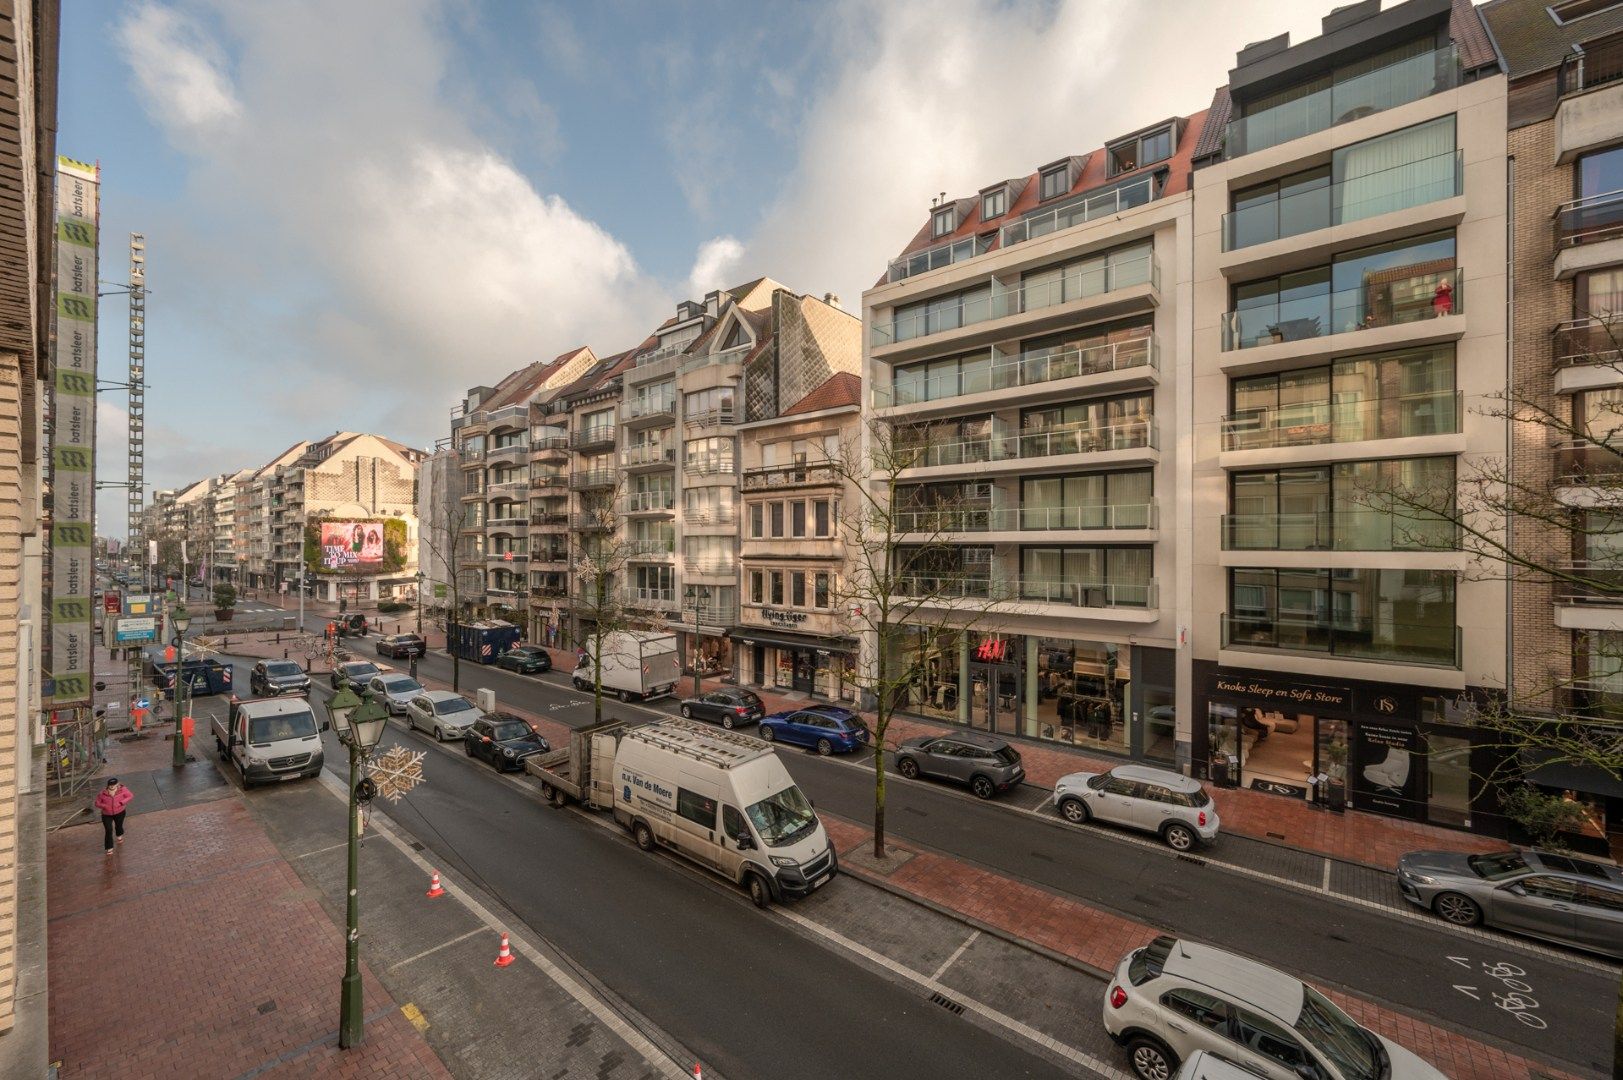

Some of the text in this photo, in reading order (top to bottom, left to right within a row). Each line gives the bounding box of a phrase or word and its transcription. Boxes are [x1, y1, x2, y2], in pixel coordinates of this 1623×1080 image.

[72, 180, 83, 217] batsleer
[71, 256, 83, 292] batsleer
[70, 330, 82, 368] batsleer
[69, 406, 81, 443] batsleer
[68, 482, 79, 520] batsleer
[324, 557, 332, 565] IT
[336, 557, 346, 565] UP
[325, 545, 344, 553] TIME
[67, 558, 79, 595] batsleer
[66, 633, 78, 671] batsleer
[1216, 681, 1246, 692] Knoks
[1247, 684, 1273, 698] Sleep
[1290, 689, 1312, 702] Sofa
[1315, 692, 1343, 704] Store
[632, 775, 643, 787] Van
[644, 780, 652, 791] de
[653, 783, 672, 799] Moere
